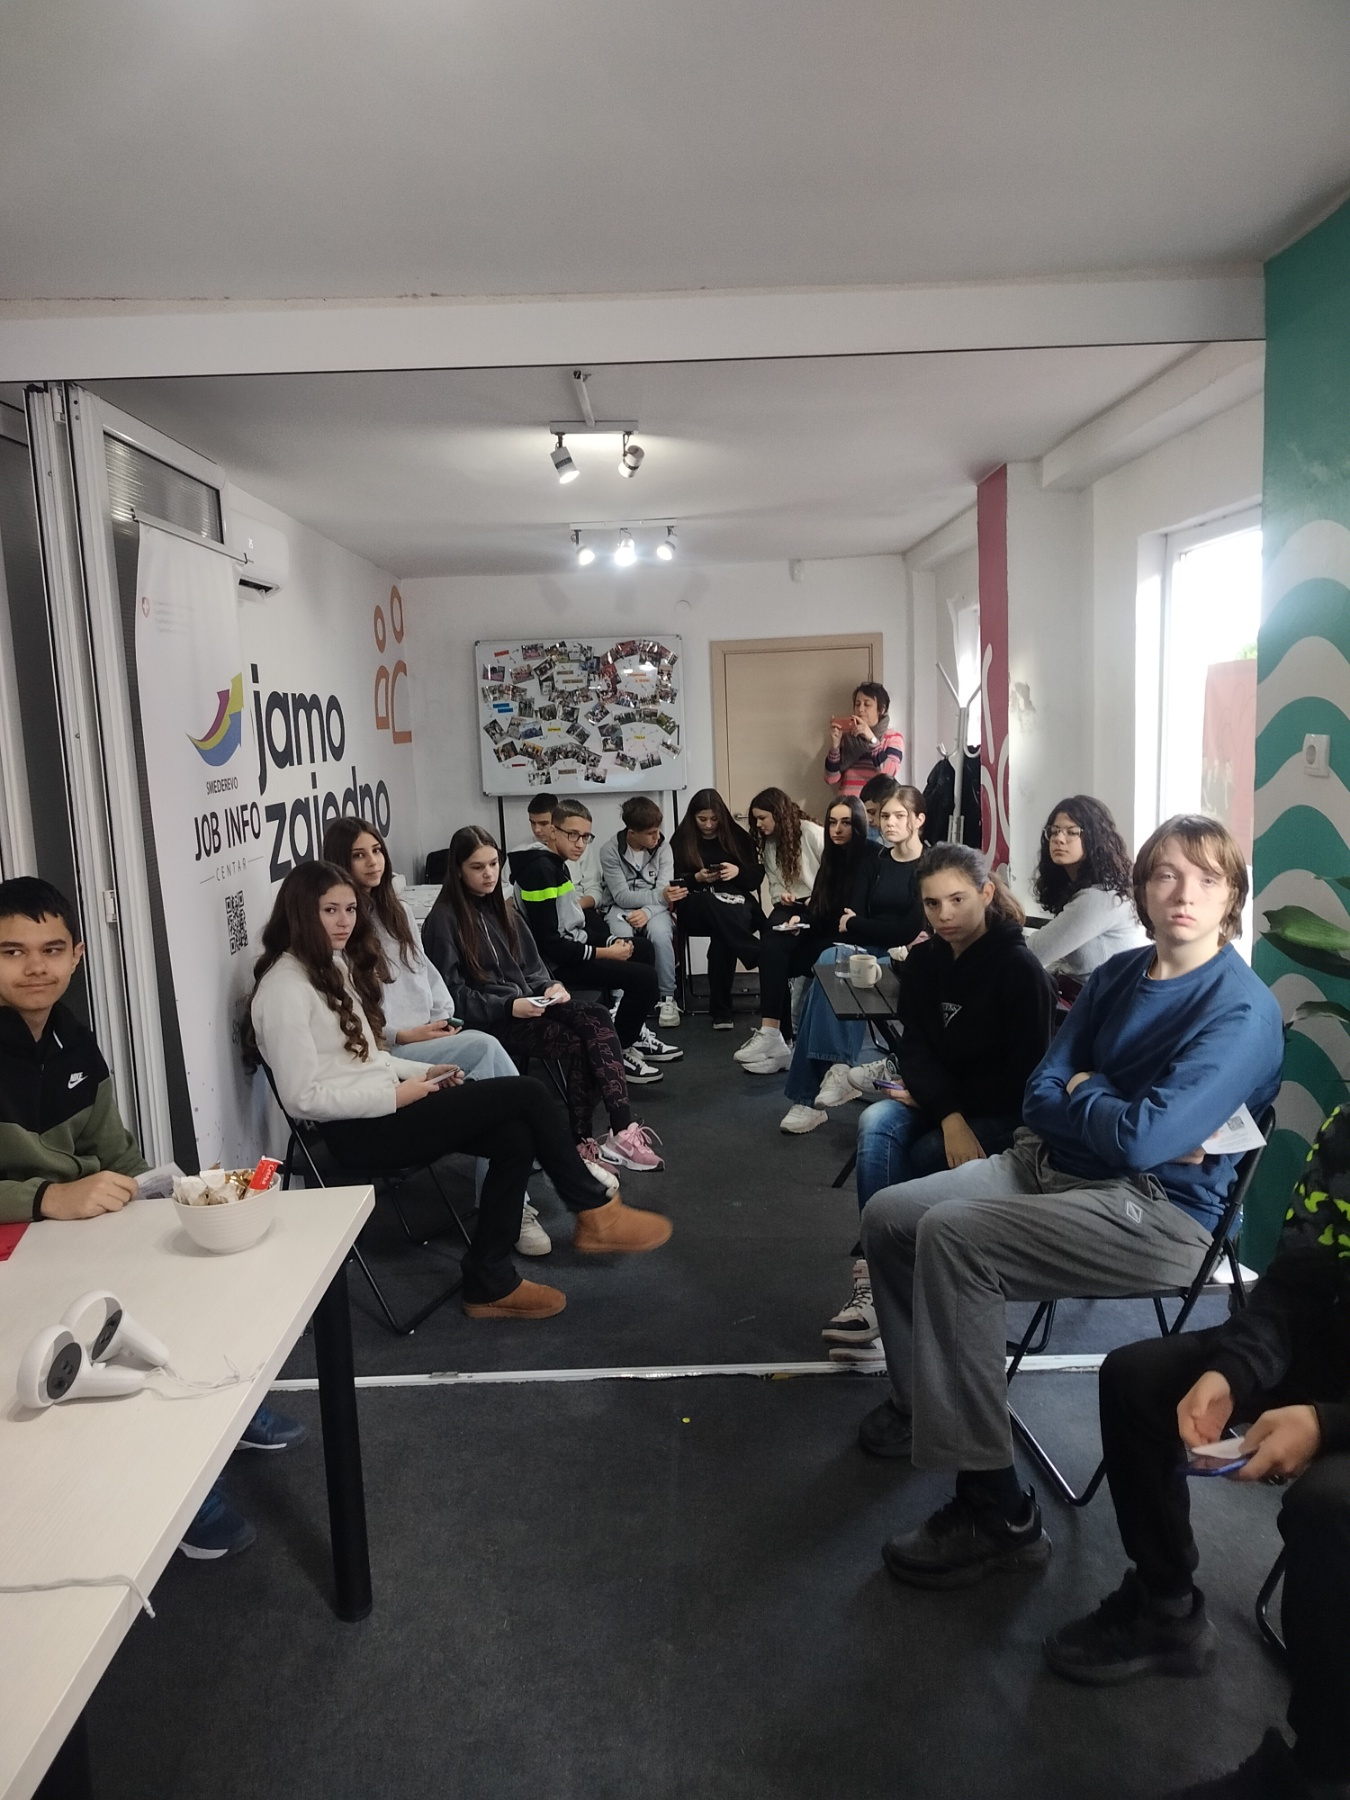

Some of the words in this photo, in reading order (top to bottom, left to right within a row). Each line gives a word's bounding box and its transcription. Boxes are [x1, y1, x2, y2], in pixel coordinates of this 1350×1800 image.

[250, 663, 345, 796] jamo
[206, 777, 238, 795] SMEDEREVO
[194, 811, 222, 861] JOB
[224, 801, 261, 848] INFO
[216, 858, 247, 881] CENTAR
